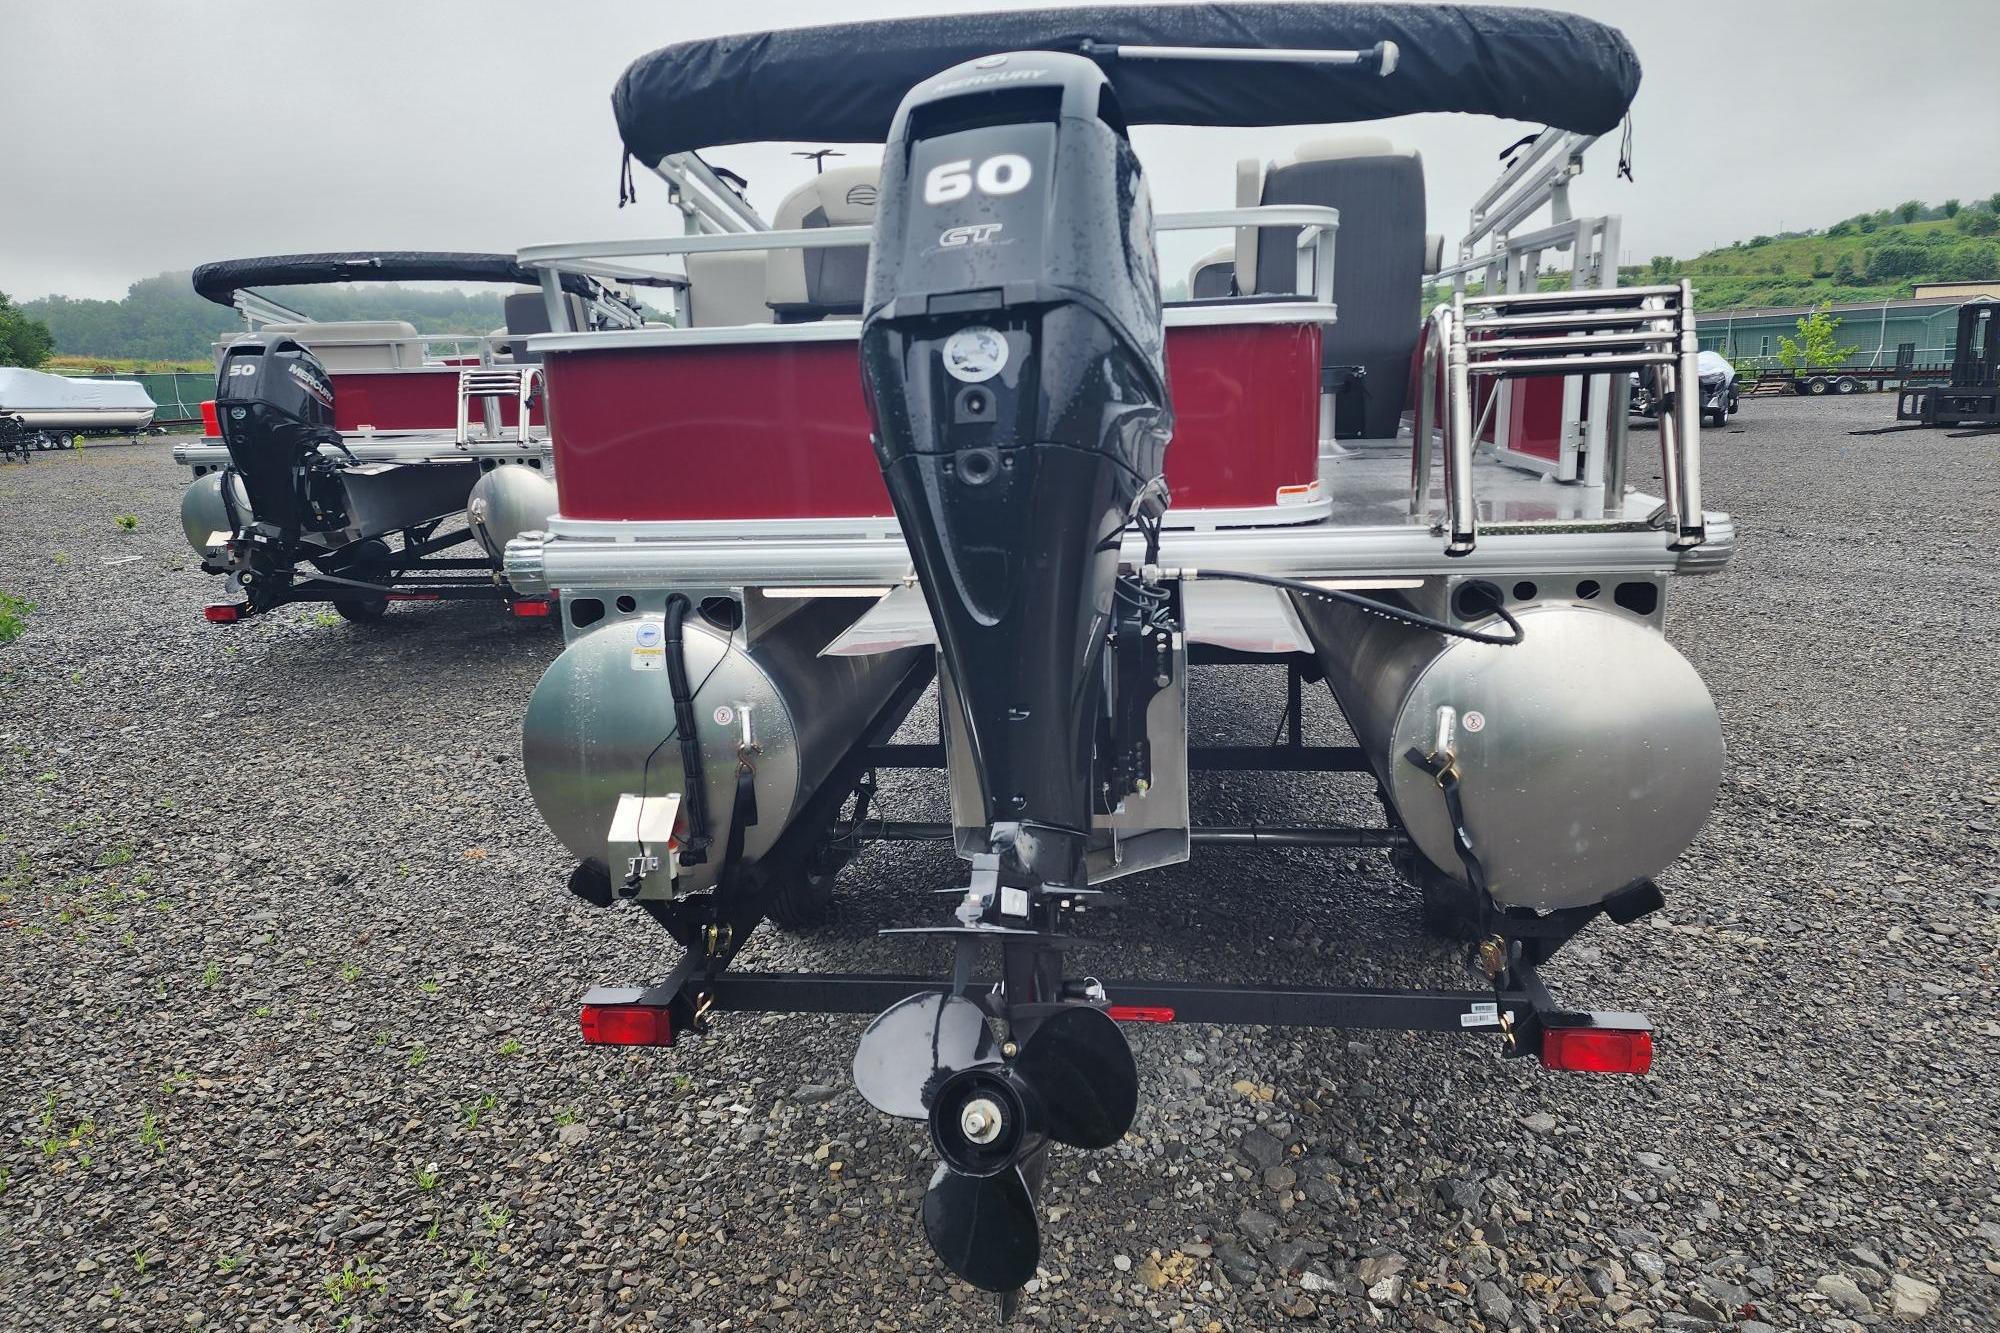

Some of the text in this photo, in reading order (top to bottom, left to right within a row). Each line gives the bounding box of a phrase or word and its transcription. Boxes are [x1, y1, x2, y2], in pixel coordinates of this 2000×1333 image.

[924, 154, 1032, 204] 60
[229, 364, 256, 377] 50
[288, 363, 333, 402] MERCURY
